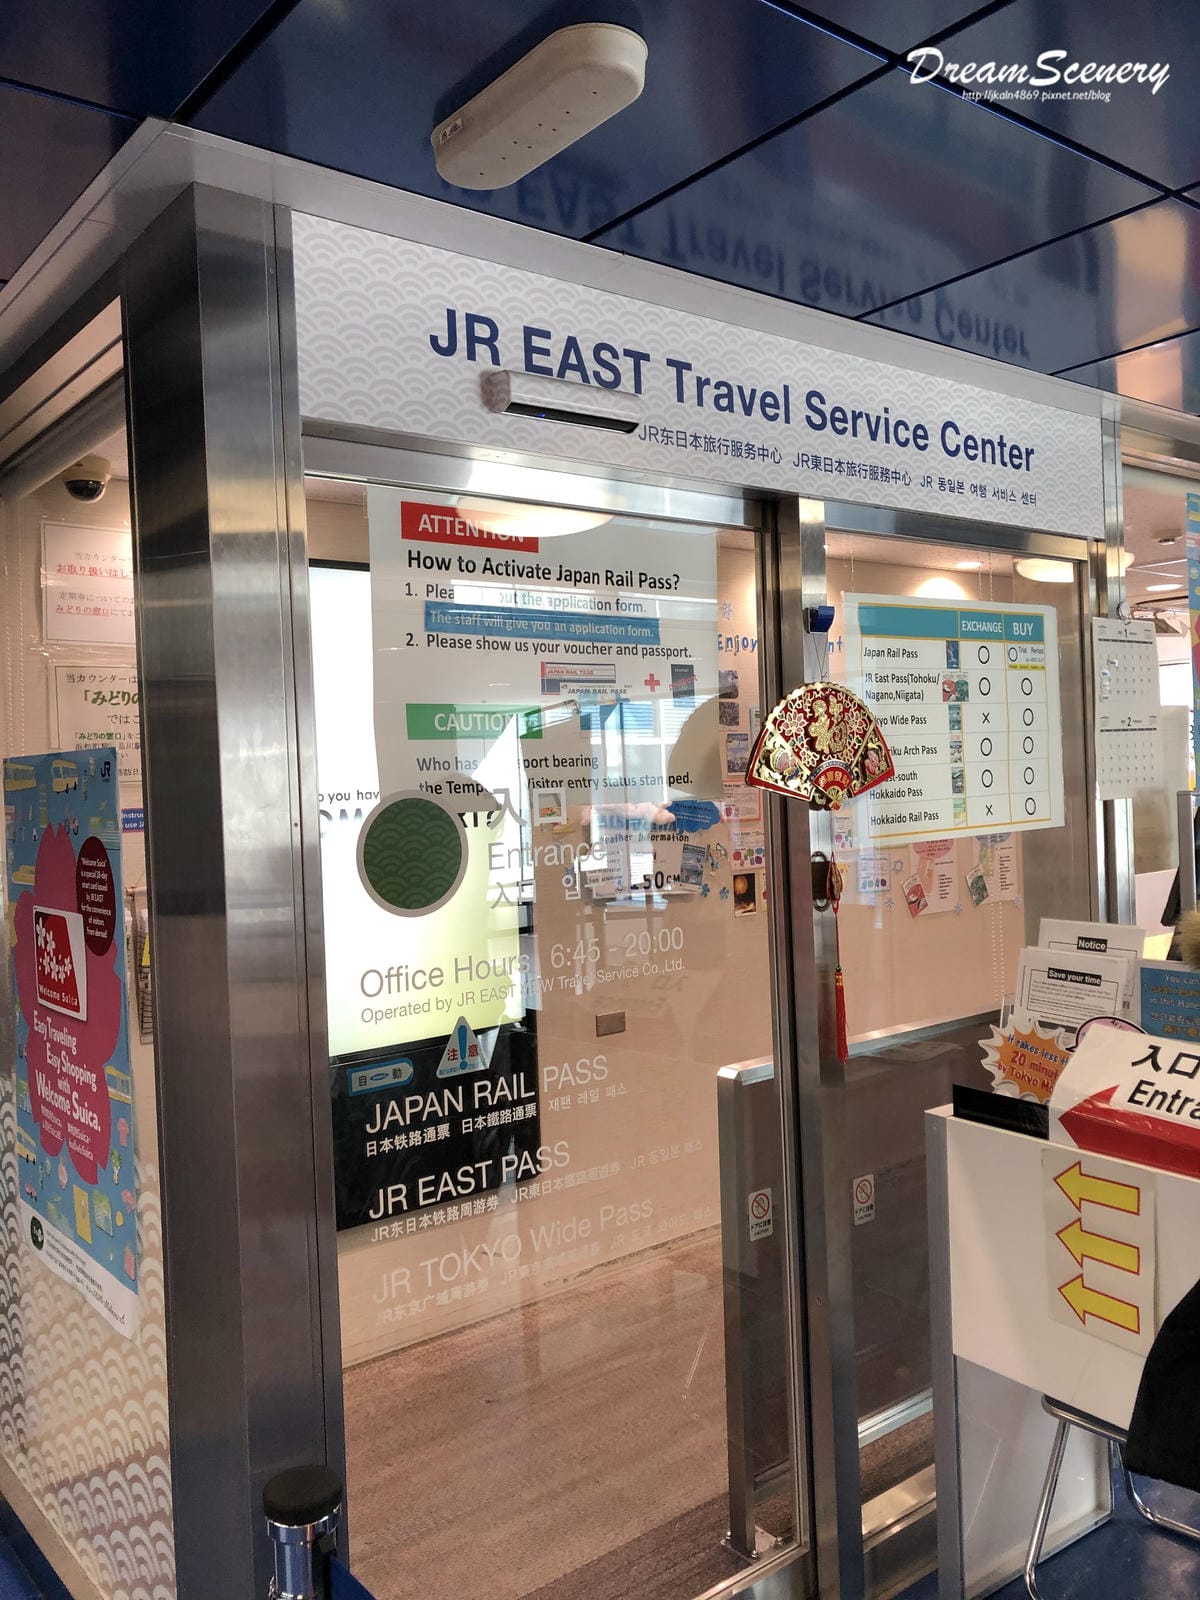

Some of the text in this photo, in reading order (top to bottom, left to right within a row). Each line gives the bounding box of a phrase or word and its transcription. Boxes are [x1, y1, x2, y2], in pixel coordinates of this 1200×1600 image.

[429, 308, 1034, 471] JR EAST Travel Service Center
[638, 424, 1037, 507] JR东日本旅行服务中心 JR東日本旅行服務中心 JR 동일본 여행 서비스 센터
[407, 549, 680, 590] How to Activate Japan Rail Pass?
[405, 582, 418, 597] 1.
[615, 599, 647, 613] form.
[430, 610, 654, 638] The staff will give you an application form.
[961, 620, 1034, 636] EXCHANGE BUY
[405, 632, 692, 660] 2. Please show us your voucher and passport.
[717, 633, 758, 654] Enjoy
[863, 647, 918, 659] Japan Rail Pass
[864, 672, 940, 685] JR East Pass(Tohoku/
[865, 689, 924, 702] Nagano,Niigata)
[889, 715, 927, 725] Wide Pass
[903, 745, 938, 756] Arch Pass
[101, 761, 111, 777] JR
[416, 755, 599, 771] Who has bearing
[419, 781, 442, 794] the
[567, 778, 599, 790] entry
[603, 775, 637, 787] status
[869, 787, 923, 800] Hokkaido Pass
[328, 790, 351, 804] you
[871, 811, 939, 826] Hokkaido Rail Pass
[488, 841, 607, 871] Entrance
[1078, 939, 1106, 950] Notice
[360, 965, 444, 998] Office
[454, 954, 531, 984] Hours
[551, 937, 600, 969] 6:45
[624, 926, 684, 958] 20:00
[1048, 969, 1101, 985] Save your time
[1165, 973, 1180, 983] You
[38, 987, 78, 1006] Welcome Suica
[361, 997, 431, 1024] Operated
[435, 996, 452, 1013] by
[457, 991, 475, 1007] JR
[480, 983, 516, 1003] EAST
[558, 972, 596, 992] Trave
[596, 967, 639, 984] Service
[642, 957, 686, 976] Co.,Ltd.
[33, 1009, 77, 1055] Easy Traveling
[447, 1044, 479, 1061] 注意
[1011, 1050, 1026, 1066] 20
[1041, 1048, 1059, 1063] less
[1131, 1044, 1200, 1079] 入口
[46, 1042, 97, 1092] Easy Shopping
[57, 1077, 70, 1094] with
[365, 1055, 608, 1134] JAPAN RAIL PASS
[35, 1069, 71, 1116] Welcome
[72, 1091, 101, 1132] Suica.
[366, 1123, 450, 1158] 日本铁路通票
[461, 1102, 537, 1135] 日本鐵路通票
[577, 1088, 600, 1104] 레일
[369, 1140, 570, 1220] JR EAST PASS
[371, 1194, 499, 1242] JR东日本铁路周游券
[373, 1267, 411, 1304] JR
[419, 1234, 522, 1288] TOKYO
[530, 1215, 591, 1253] Wide
[600, 1199, 654, 1232] Pass
